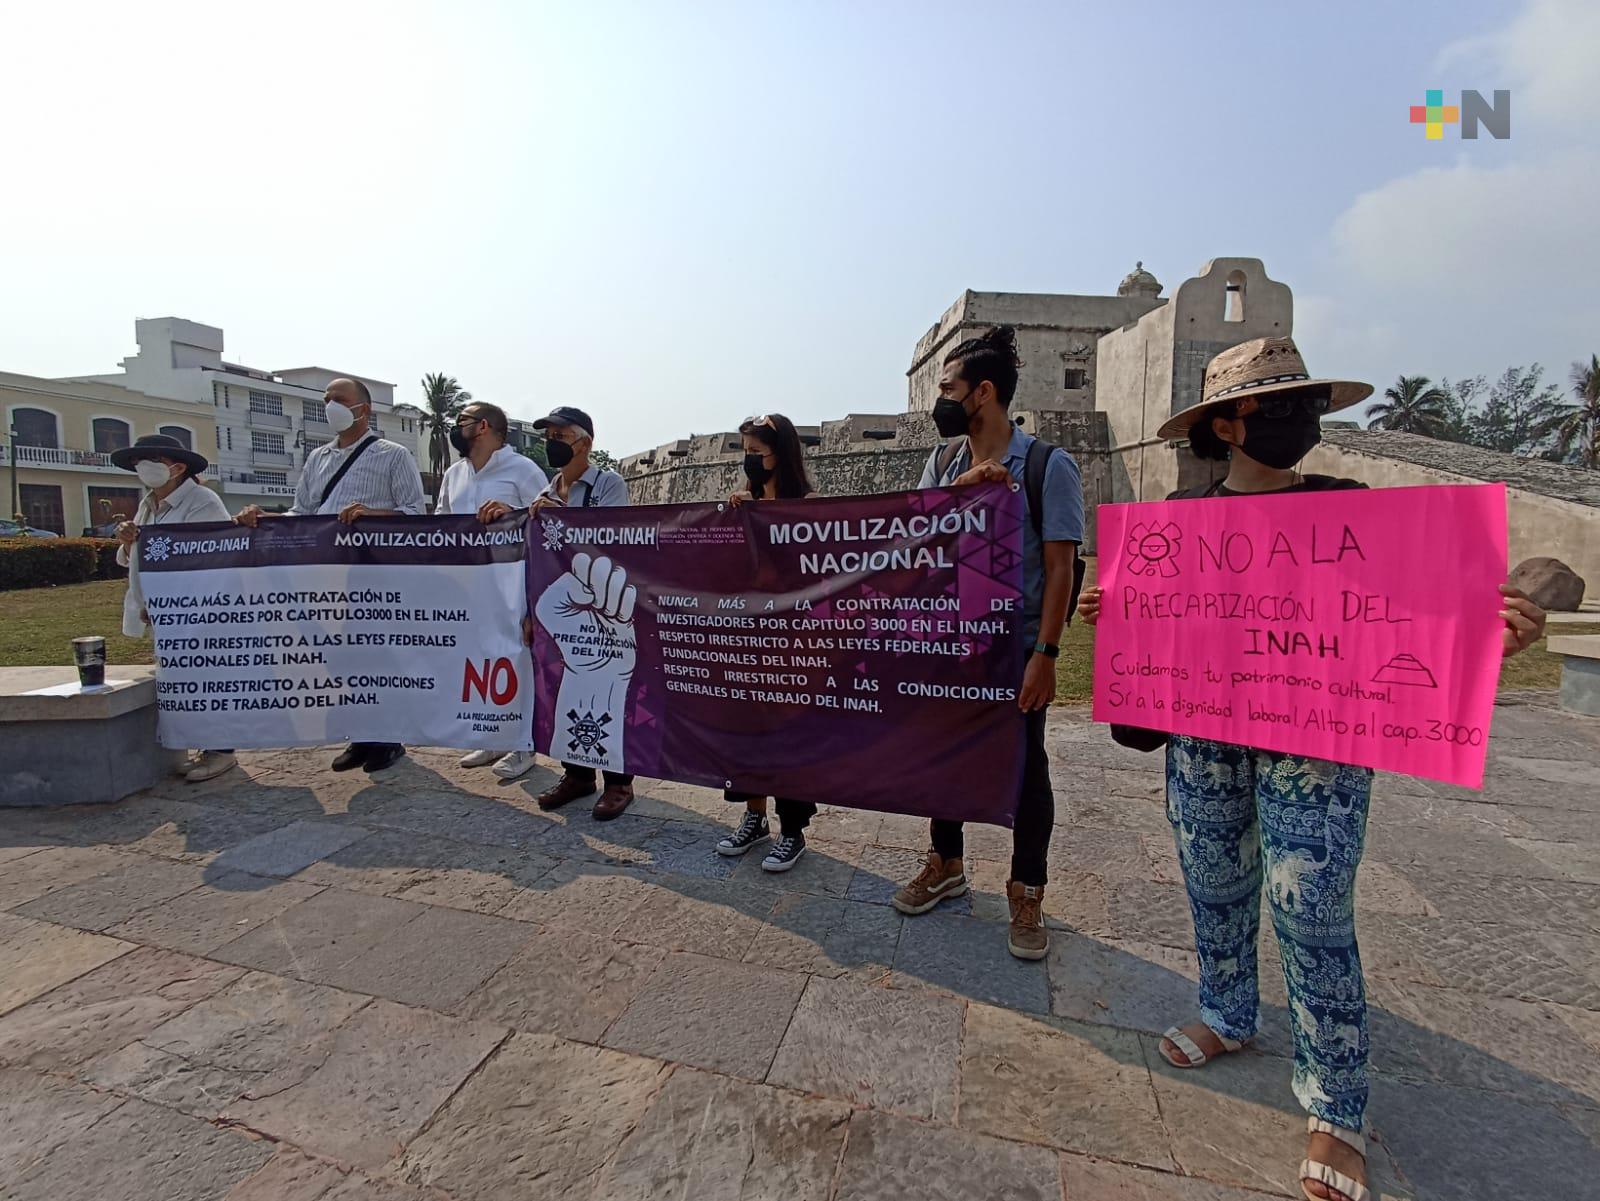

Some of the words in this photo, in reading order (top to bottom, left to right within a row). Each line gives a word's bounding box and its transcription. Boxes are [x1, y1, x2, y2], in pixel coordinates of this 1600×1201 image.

[564, 527, 656, 545] SNPICD-INAH
[769, 508, 986, 545] MOVILIZACIÓN
[172, 537, 250, 555] SNPICD-INAH
[334, 530, 457, 547] MOVILIZACIÓN
[461, 528, 524, 547] NACIONAL
[1198, 530, 1254, 574] NO
[1267, 531, 1298, 568] A
[1312, 524, 1366, 564] LA
[800, 546, 954, 574] NACIONAL
[148, 596, 198, 609] NUNCA
[201, 592, 231, 608] MÁS
[234, 594, 246, 606] A
[250, 594, 265, 606] LA
[267, 588, 382, 604] CONTRATACIÓN
[386, 592, 402, 604] DE
[658, 595, 698, 608] NUNCA
[717, 596, 746, 610] MÁS
[764, 600, 774, 610] A
[795, 600, 812, 611] LA
[836, 594, 960, 612] CONTRATACIÓN
[990, 598, 1014, 612] DE
[1124, 586, 1314, 622] PRECARIZACIÓN
[1341, 590, 1412, 624] DEL
[150, 611, 254, 626] VESTIGADORES
[257, 610, 284, 622] POR
[395, 609, 411, 621] EN
[414, 609, 428, 622] EL
[432, 609, 470, 622] INAH.
[656, 612, 755, 630] INVESTIGADORES
[760, 618, 788, 630] POR
[792, 618, 866, 632] CAPITULO
[870, 618, 908, 632] 3000
[911, 620, 932, 632] EN
[937, 620, 956, 634] EL
[960, 620, 1010, 634] INAH.
[580, 624, 596, 634] NO
[157, 638, 200, 651] SPETO
[204, 635, 294, 650] IRRESTRICTO
[297, 635, 309, 646] A
[313, 634, 342, 647] LAS
[347, 634, 385, 646] LEYES
[388, 634, 457, 648] FEDERALES
[553, 632, 637, 650] PRECARIZACIÓN
[658, 630, 705, 644] RESPETO
[708, 634, 789, 649] IRRESTRICTO
[793, 638, 804, 649] A
[808, 638, 834, 650] LAS
[838, 638, 880, 651] LEYES
[884, 638, 971, 656] FEDERALES
[1244, 628, 1345, 660] INAH.
[159, 654, 250, 668] DACIONALES
[253, 653, 278, 666] DEL
[282, 652, 328, 665] INAH.
[572, 646, 594, 656] DEL
[598, 648, 624, 660] INAH
[662, 647, 758, 666] FUNDACIONALES
[762, 656, 788, 667] DEL
[791, 656, 832, 668] INAH.
[202, 678, 294, 694] IRRESTRICTO
[297, 679, 310, 690] A
[314, 676, 344, 690] LAS
[347, 676, 435, 690] CONDICIONES
[462, 656, 518, 706] NO
[664, 664, 710, 679] RESPETO
[724, 670, 808, 686] IRRESTRICTO
[826, 676, 837, 688] A
[854, 678, 880, 692] LAS
[897, 682, 1016, 701] CONDICIONES
[1111, 652, 1190, 681] Cuidamos
[1204, 661, 1222, 684] tu
[1231, 668, 1322, 690] patrimonio
[1329, 680, 1396, 704] cultural.
[210, 699, 228, 712] DE
[232, 696, 300, 712] TRABAJO
[304, 695, 335, 708] DEL
[339, 692, 380, 706] INAH.
[666, 680, 728, 698] GENERALES
[730, 688, 748, 700] DE
[750, 690, 811, 705] TRABAJO
[816, 694, 840, 708] DEL
[843, 697, 883, 714] INAH.
[456, 712, 462, 720] A
[463, 712, 471, 720] LA
[1136, 696, 1146, 708] a
[1153, 688, 1165, 710] la
[1171, 691, 1232, 718] dignidad
[1304, 708, 1348, 736] Alto
[1354, 711, 1376, 738] al
[1382, 724, 1422, 747] cap.
[1426, 719, 1482, 746] 3000
[472, 724, 482, 732] DEL
